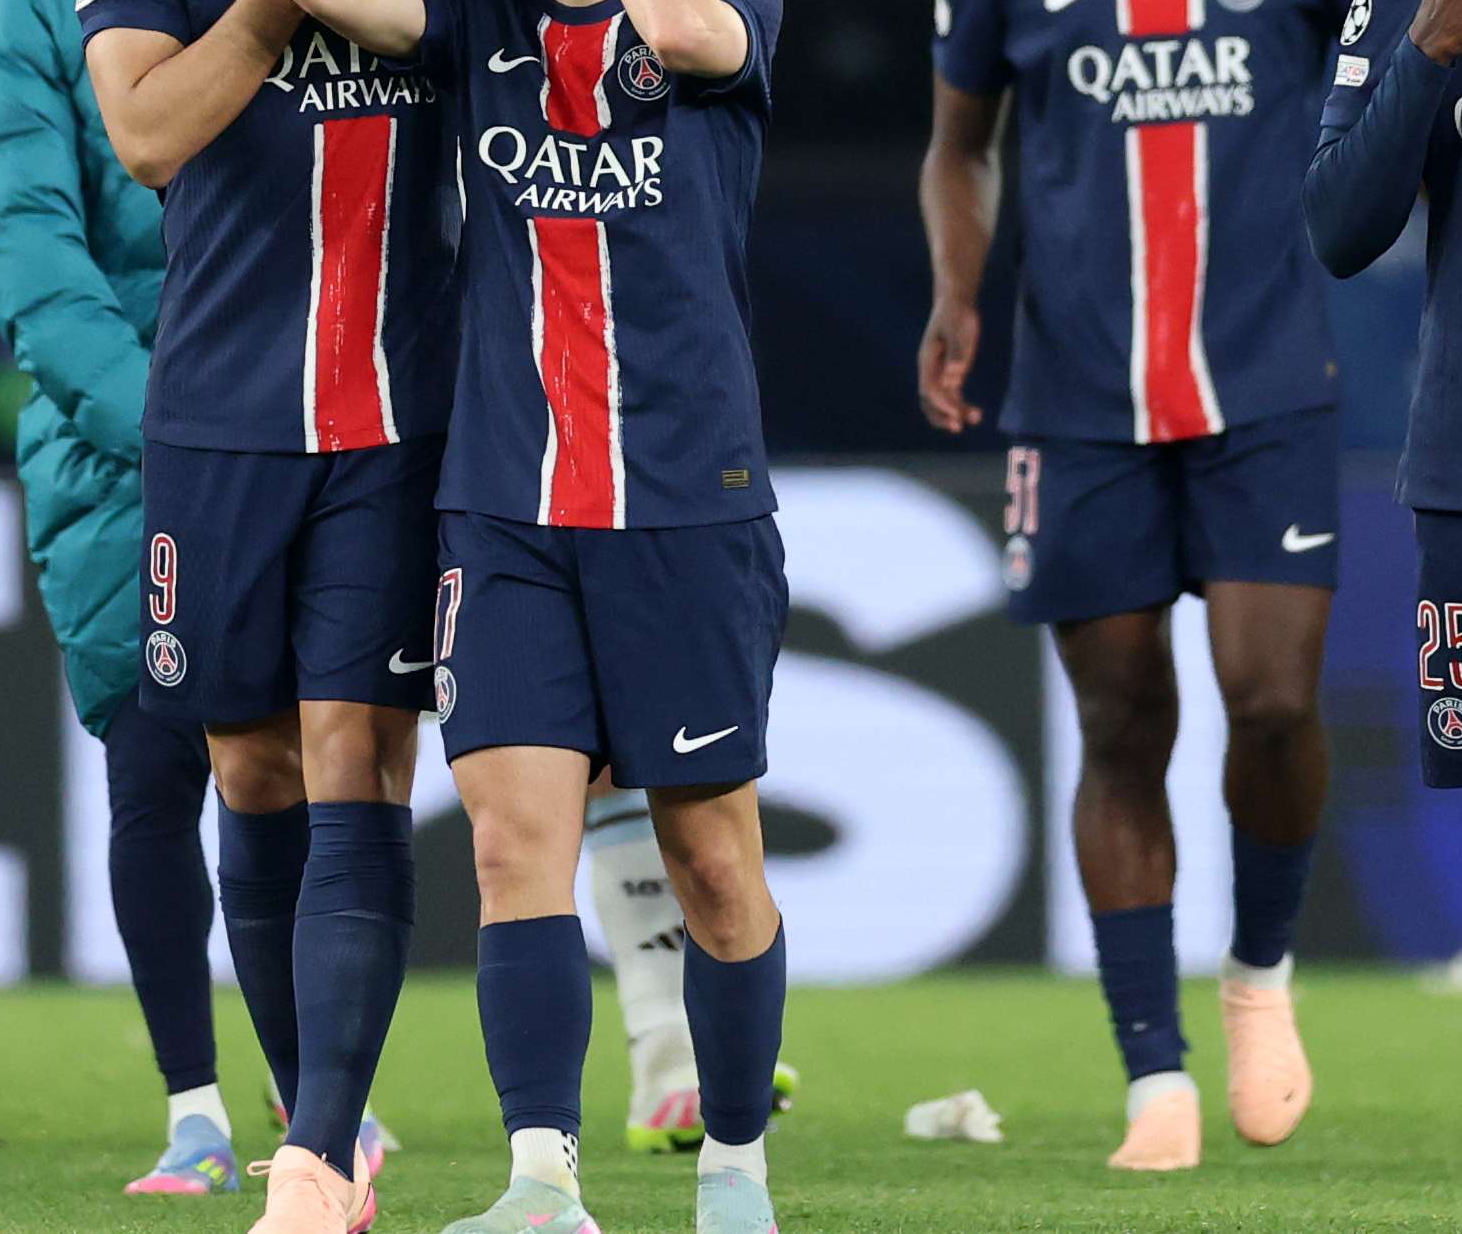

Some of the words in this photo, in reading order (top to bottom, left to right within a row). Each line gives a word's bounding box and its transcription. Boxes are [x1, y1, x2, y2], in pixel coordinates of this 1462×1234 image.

[624, 47, 658, 64] PARI
[1067, 36, 1253, 104] QATAR
[1111, 82, 1256, 124] AIRWAYS
[477, 125, 665, 188] QATAR
[514, 177, 664, 214] AIRWAYS
[149, 532, 177, 625] 9
